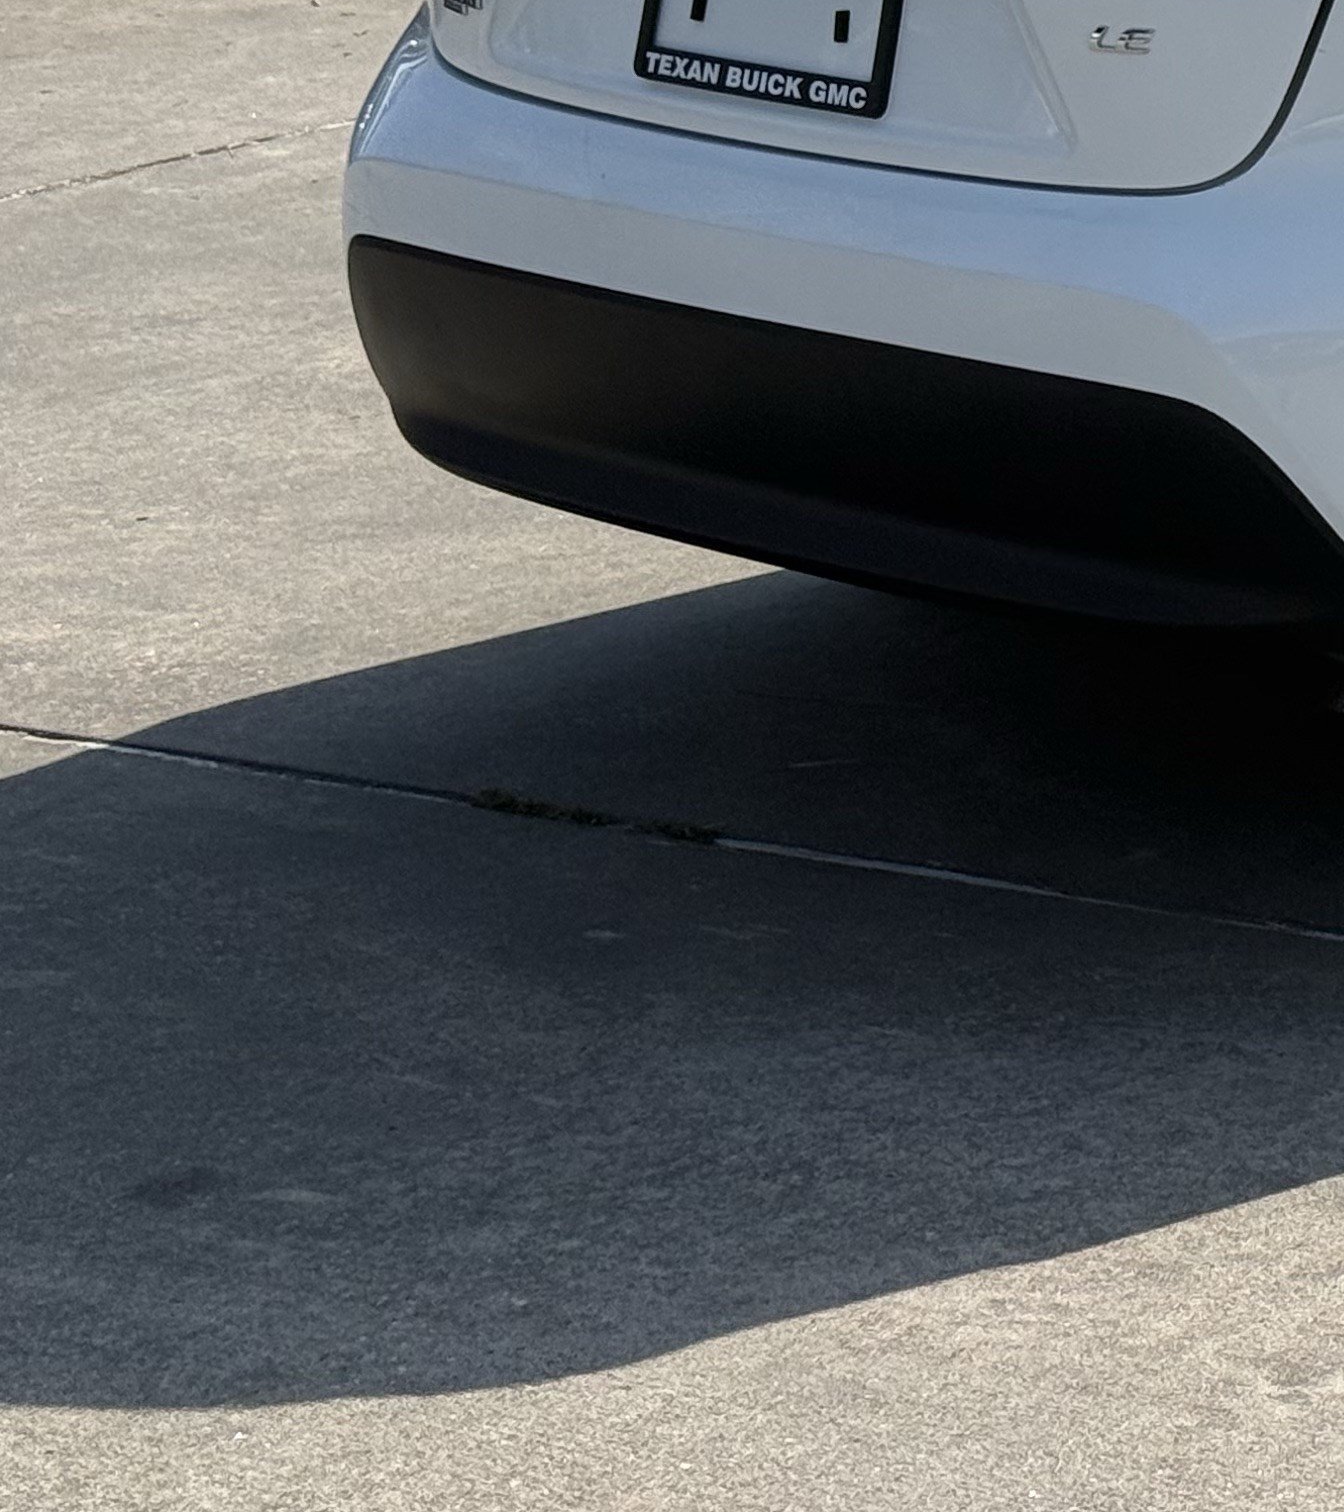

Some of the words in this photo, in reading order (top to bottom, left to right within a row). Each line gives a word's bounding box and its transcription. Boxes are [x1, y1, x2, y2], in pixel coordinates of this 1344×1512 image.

[1089, 25, 1156, 55] LE
[645, 50, 721, 85] TEXAN
[725, 65, 804, 100] BUICK
[808, 79, 868, 110] GMC
